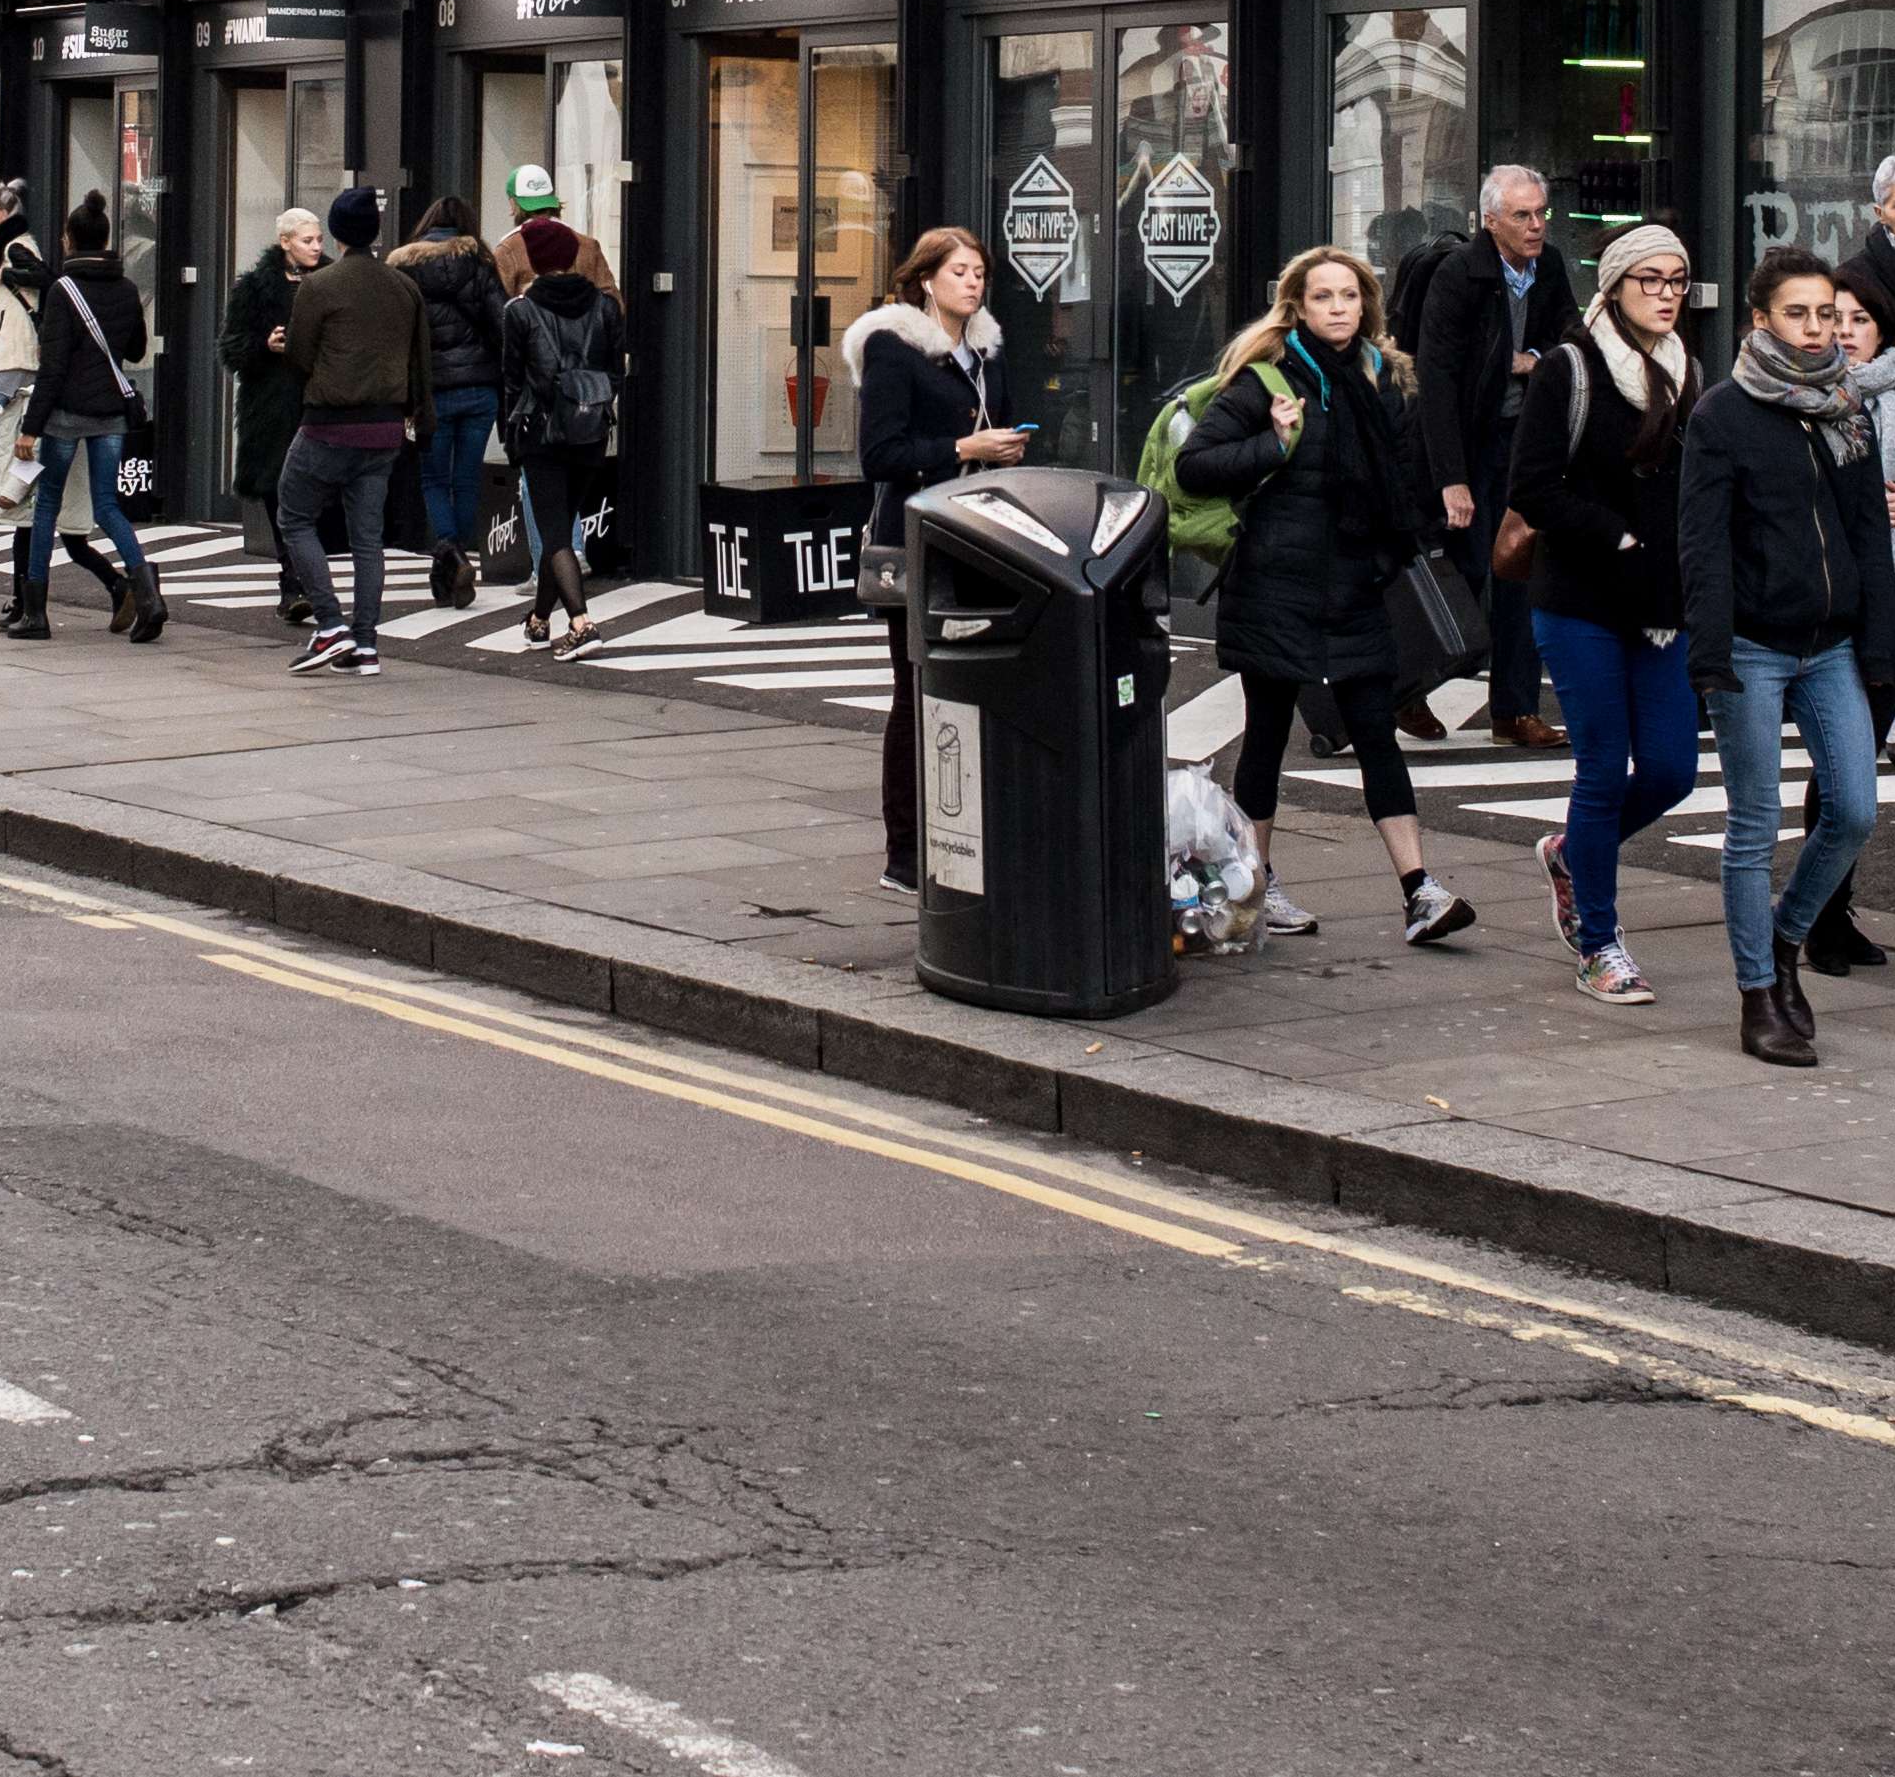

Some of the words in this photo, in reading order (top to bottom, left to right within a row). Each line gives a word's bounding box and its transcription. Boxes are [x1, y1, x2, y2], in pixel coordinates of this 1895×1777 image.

[267, 7, 318, 16] WANDERING
[319, 9, 345, 17] MINDS
[438, 0, 456, 27] 08
[91, 26, 129, 40] Sugar
[196, 21, 210, 47] 09
[33, 38, 44, 61] 10
[1014, 211, 1039, 239] JUST
[1039, 211, 1067, 239] HYPE
[1149, 213, 1175, 242] JUST
[1177, 213, 1209, 242] HYPE
